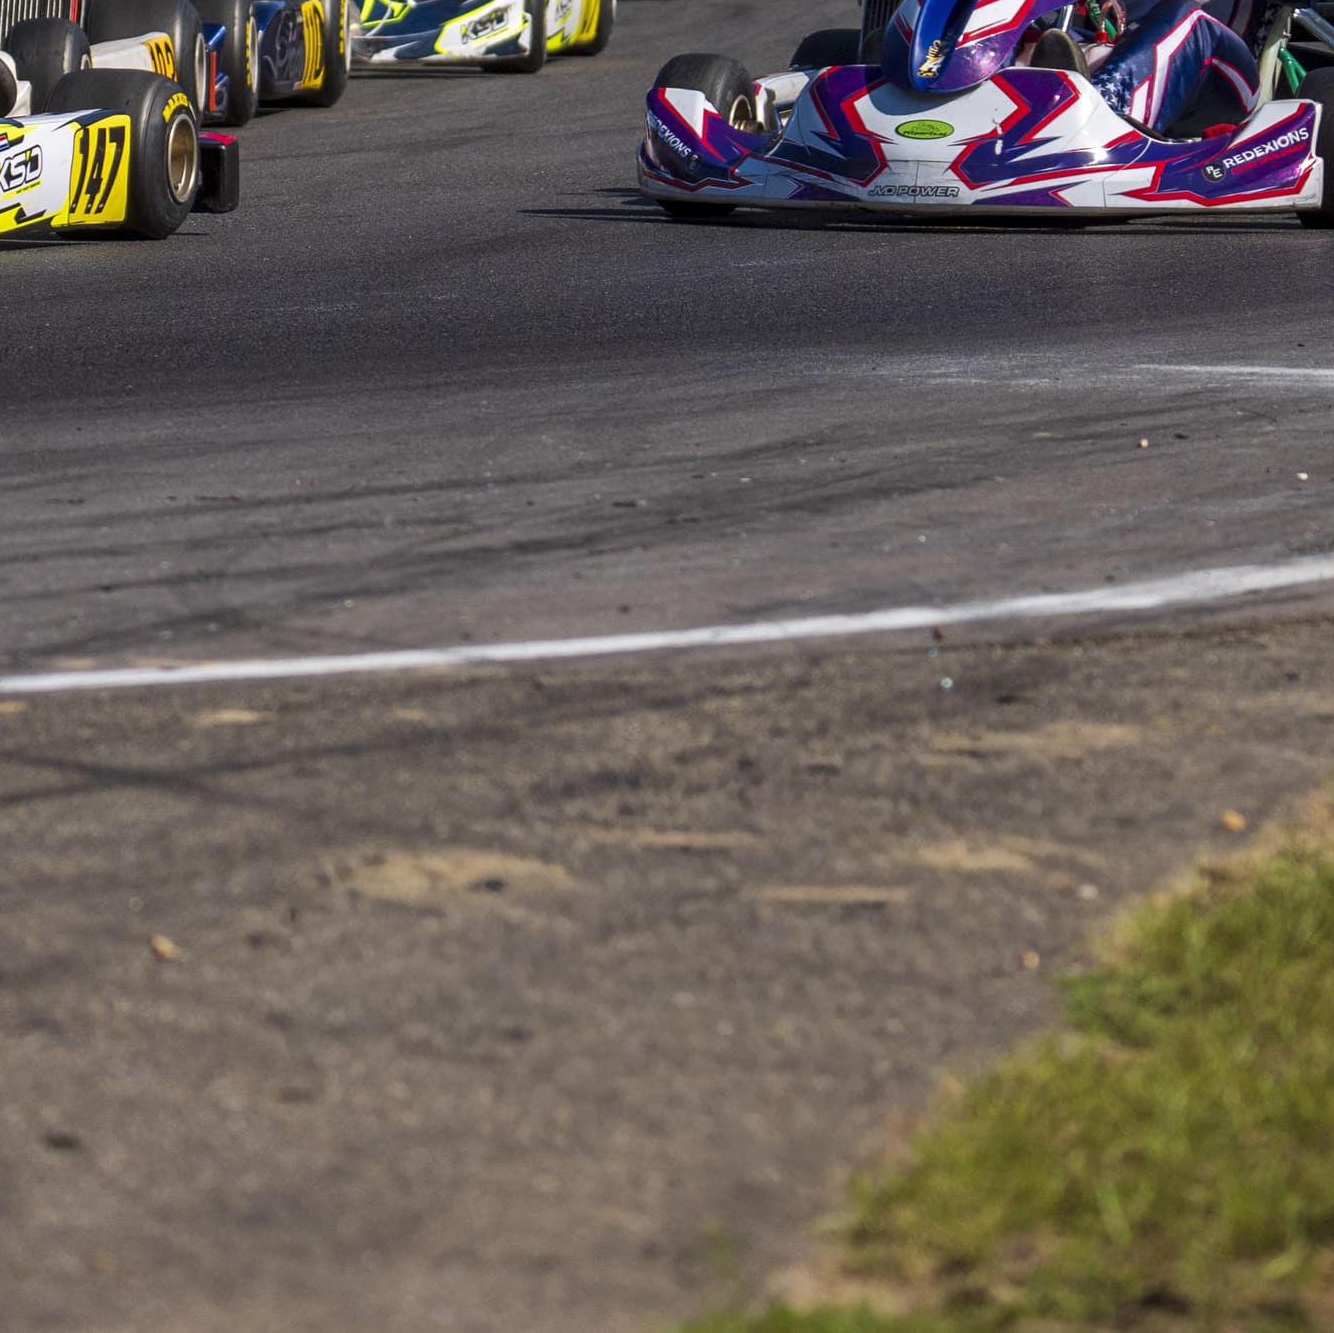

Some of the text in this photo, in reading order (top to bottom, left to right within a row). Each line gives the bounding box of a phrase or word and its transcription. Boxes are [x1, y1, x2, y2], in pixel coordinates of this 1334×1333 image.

[462, 7, 510, 43] KSD
[1222, 127, 1310, 169] REDEXIONS
[69, 125, 126, 214] 147
[896, 185, 960, 197] POWER
